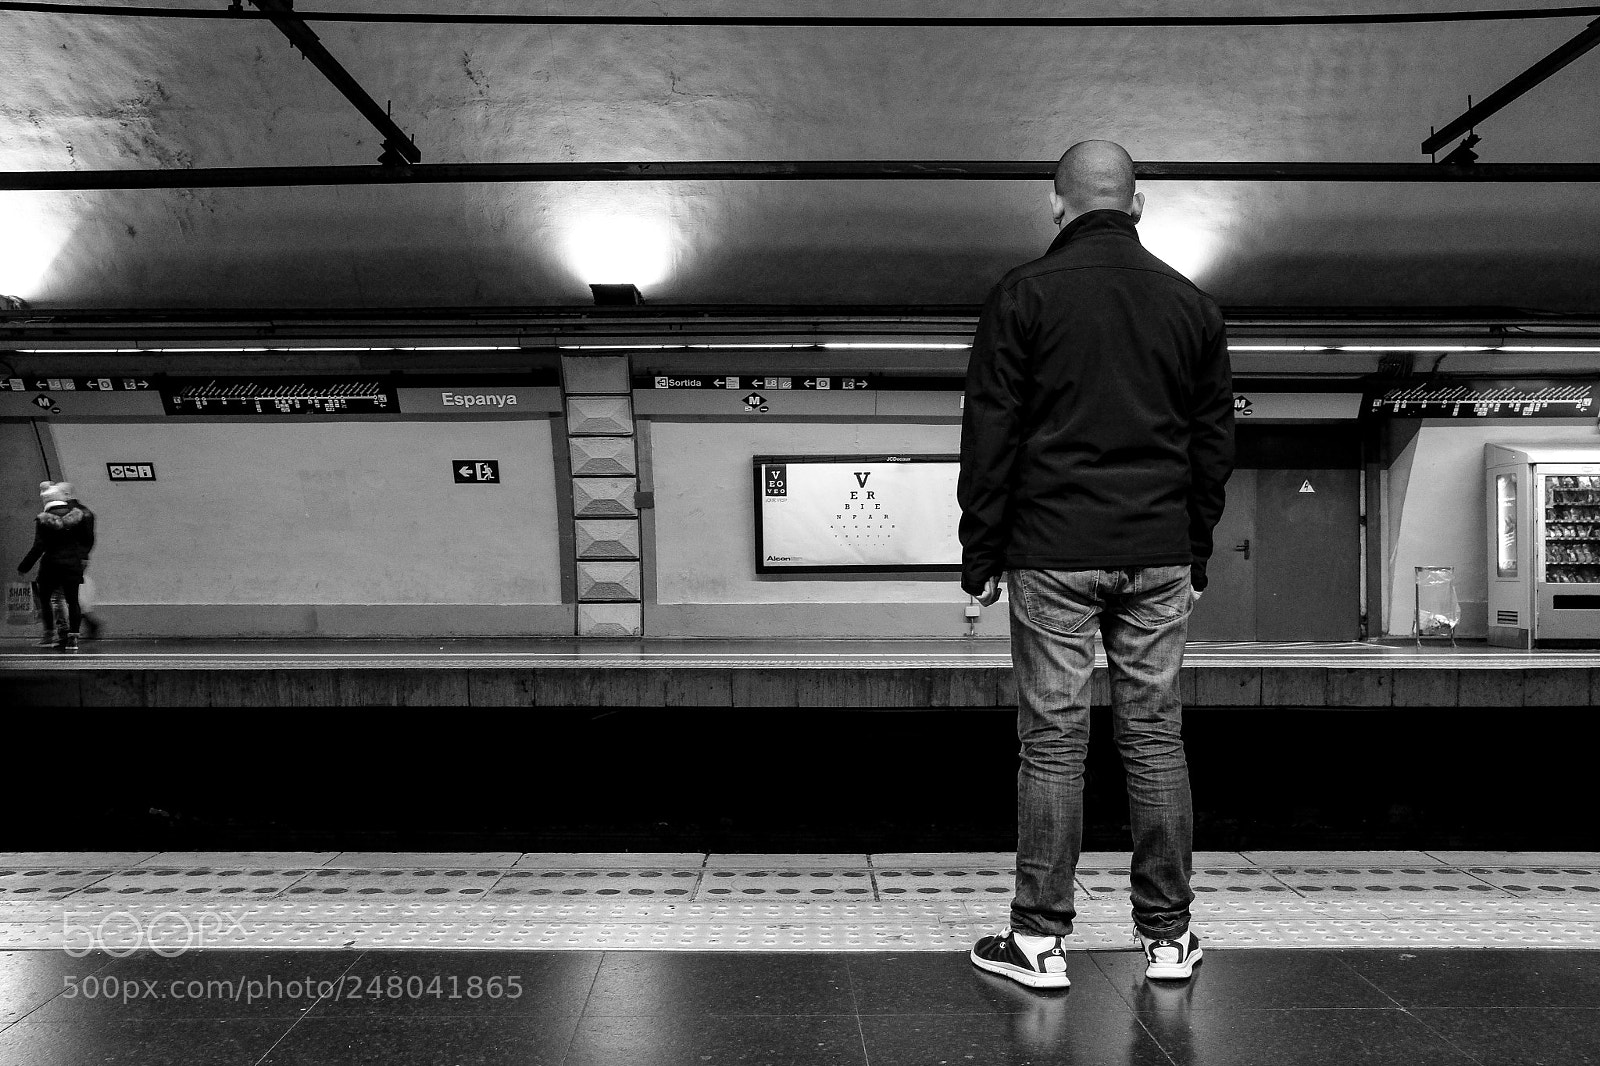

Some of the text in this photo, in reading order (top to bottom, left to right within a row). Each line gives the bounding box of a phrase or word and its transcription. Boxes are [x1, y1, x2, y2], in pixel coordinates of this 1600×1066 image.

[124, 382, 136, 390] L3
[668, 379, 702, 387] Sortida
[765, 379, 777, 387] L8
[843, 381, 855, 389] L3
[37, 397, 51, 407] M
[442, 391, 518, 409] Espanya
[748, 396, 760, 405] M
[771, 470, 781, 480] V
[854, 472, 871, 488] V
[9, 587, 31, 597] SHARE
